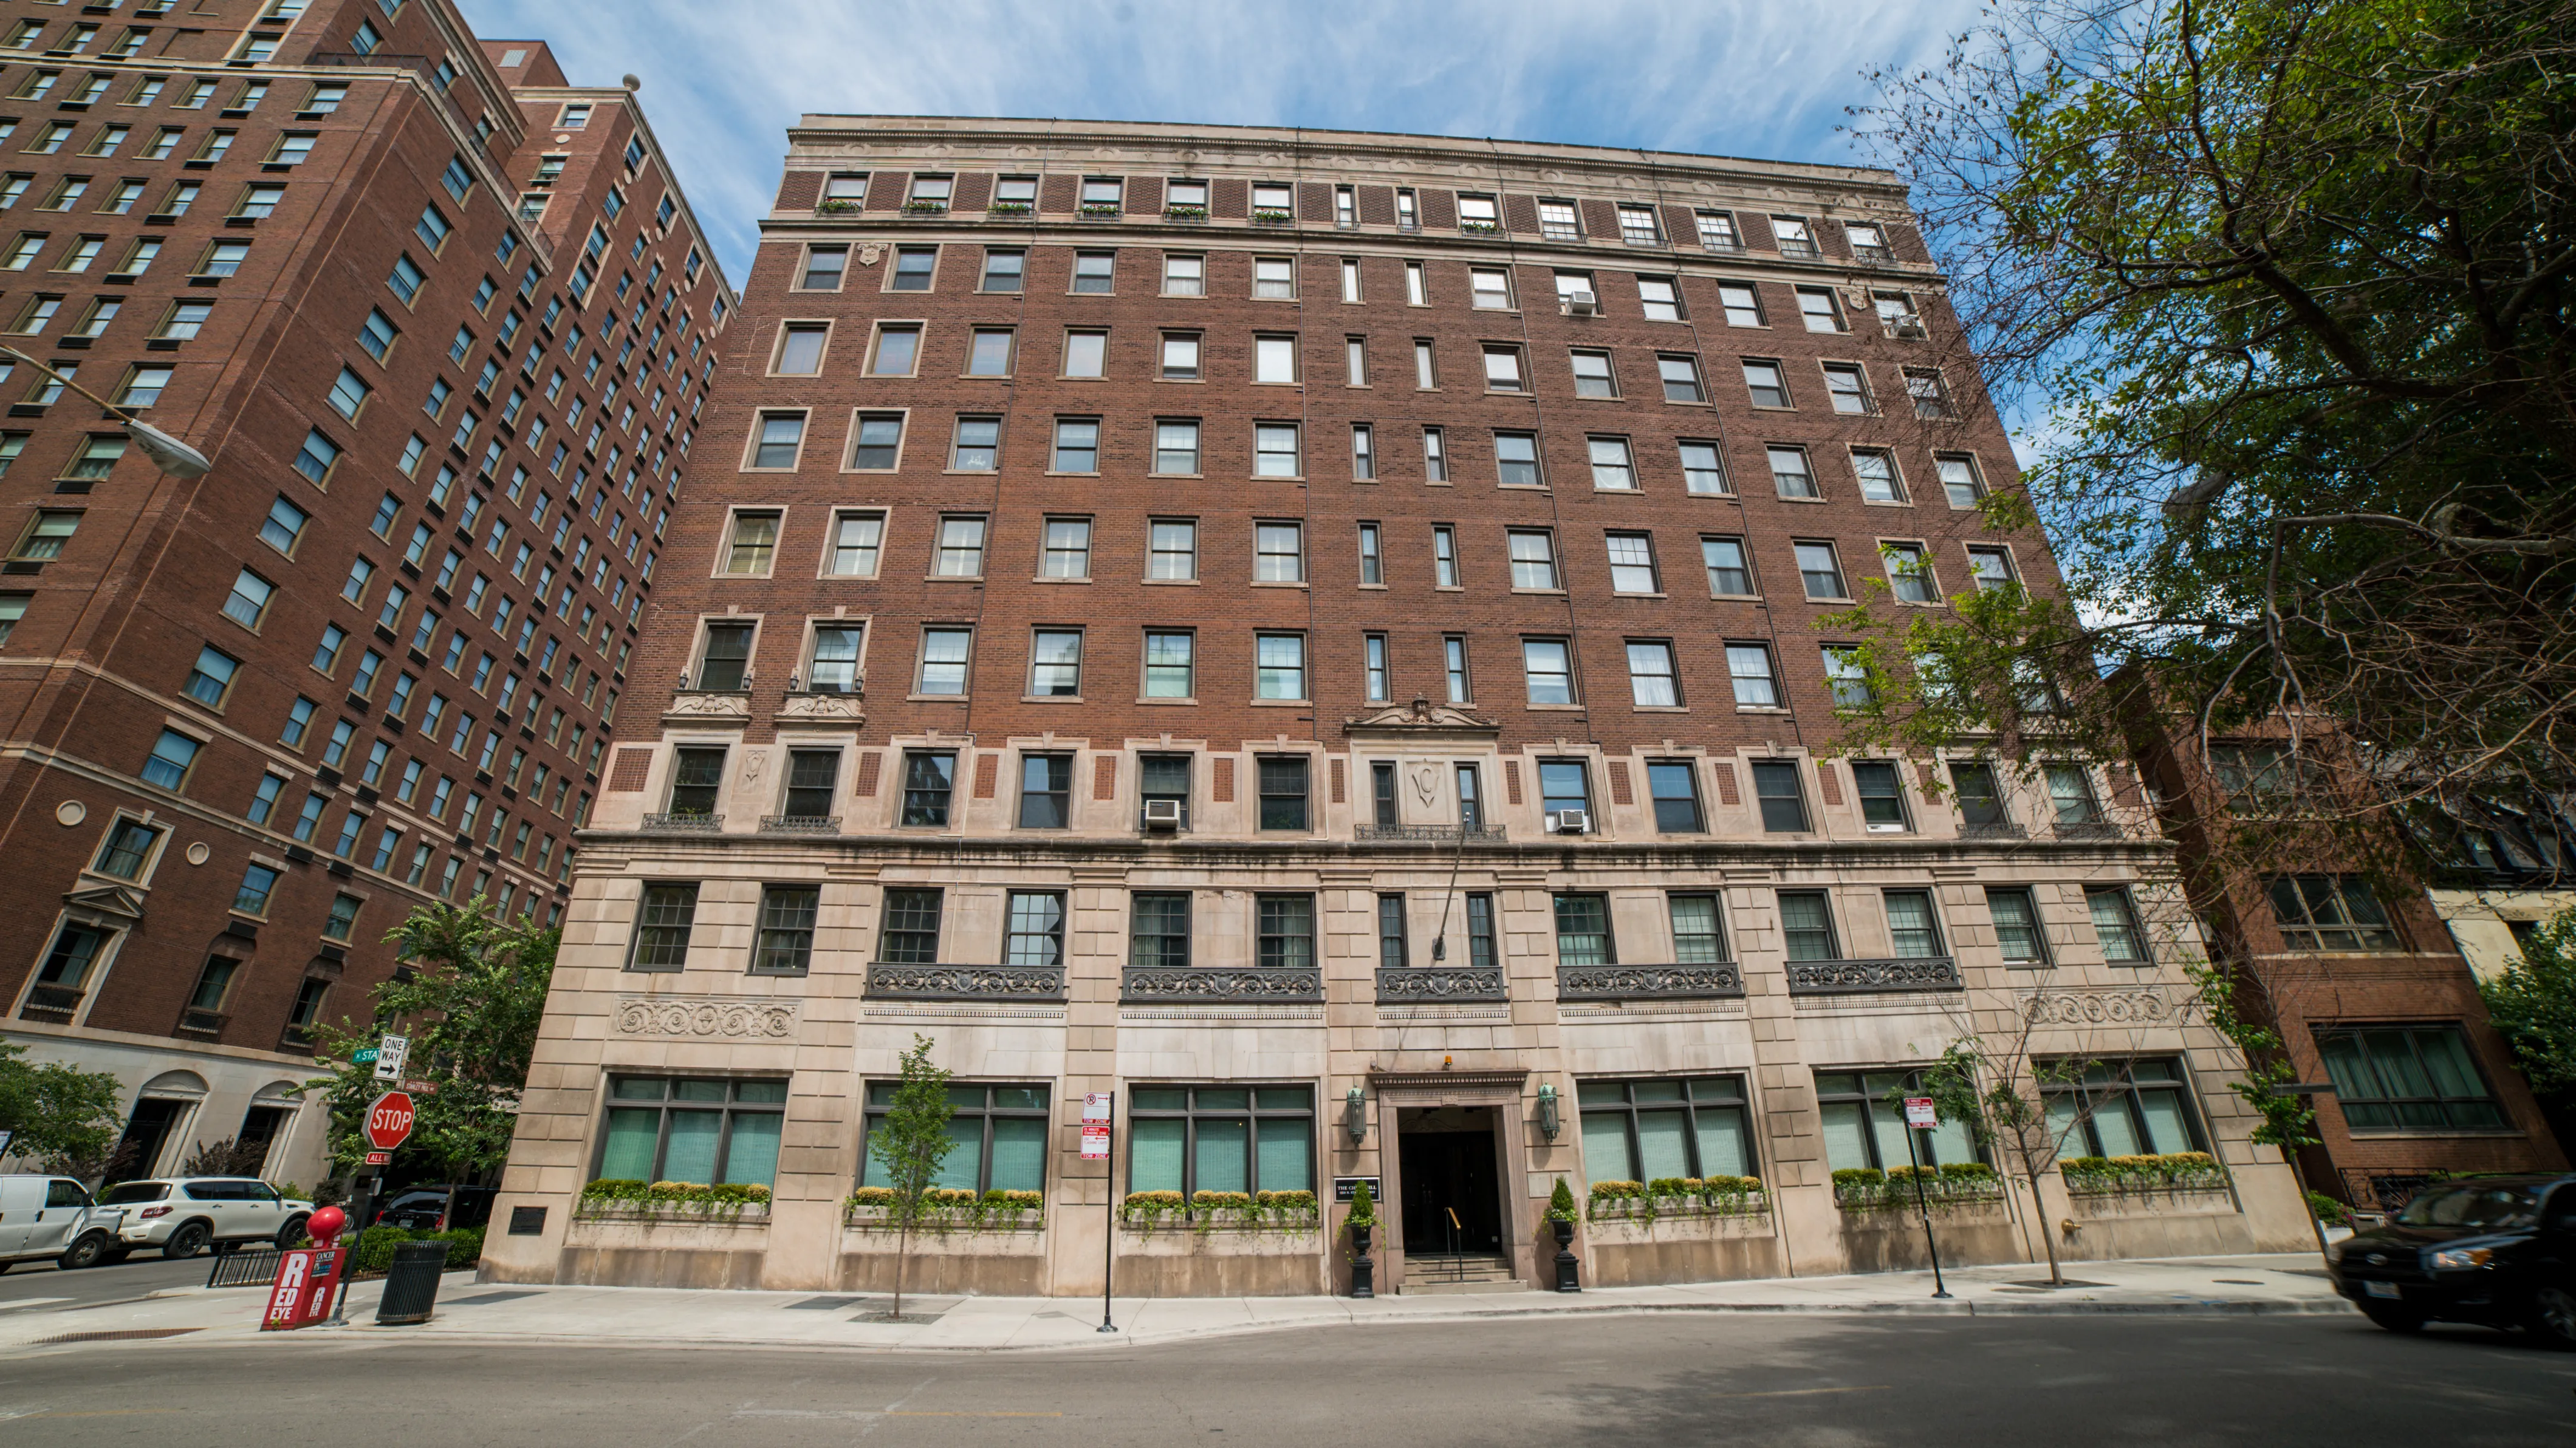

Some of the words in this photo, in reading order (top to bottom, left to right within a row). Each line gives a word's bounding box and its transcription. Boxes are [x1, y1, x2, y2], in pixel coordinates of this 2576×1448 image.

[385, 1039, 403, 1051] ONE
[362, 1050, 380, 1060] STA
[382, 1051, 401, 1062] WAY
[372, 1108, 411, 1131] STOP
[316, 1251, 335, 1260] CANCER
[280, 1253, 308, 1287] R
[273, 1288, 298, 1306] ED
[313, 1287, 326, 1302] R
[312, 1302, 321, 1311] ED
[269, 1307, 293, 1320] EYE
